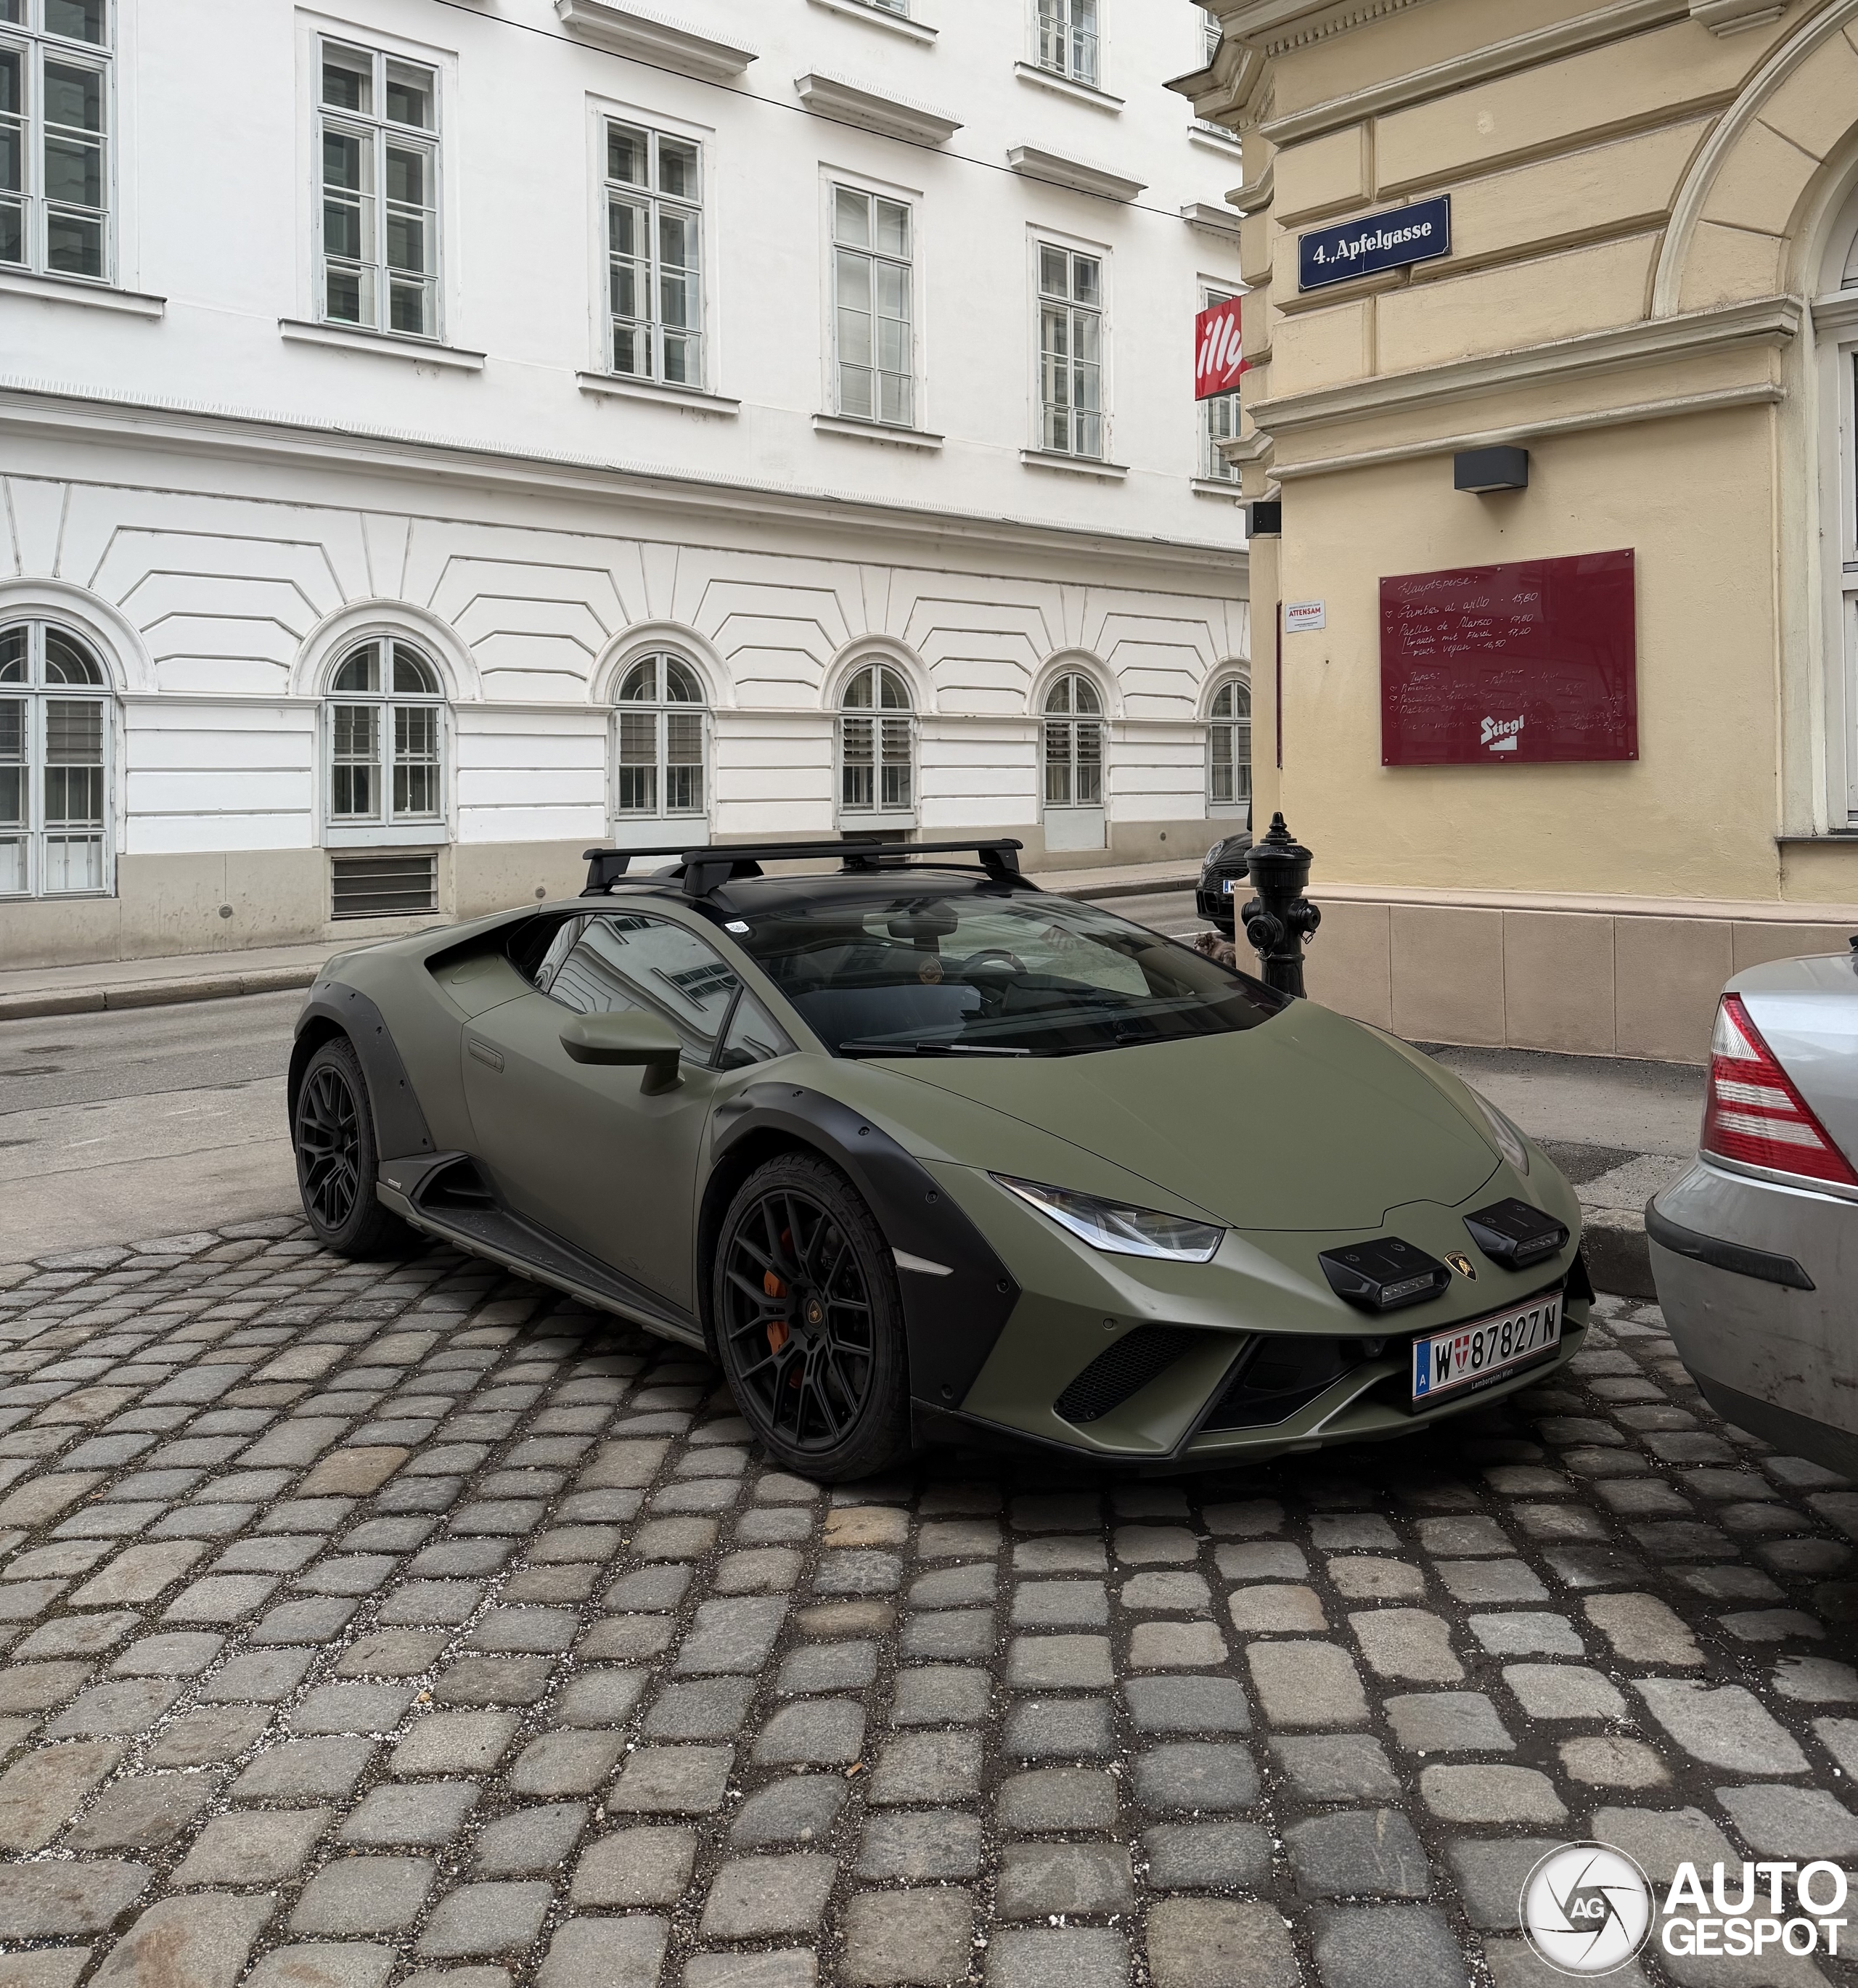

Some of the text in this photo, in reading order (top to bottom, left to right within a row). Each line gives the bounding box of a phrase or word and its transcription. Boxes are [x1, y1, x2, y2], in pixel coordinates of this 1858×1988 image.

[1197, 312, 1243, 383] illy
[1289, 607, 1320, 617] ATTENSAM
[1397, 592, 1539, 618] Gambas al ajillo 15,80
[1399, 623, 1432, 637] Paella
[1437, 621, 1449, 631] de
[1441, 633, 1459, 642] mit
[1442, 643, 1471, 658] vegan
[1410, 671, 1441, 684] Tapas:
[1481, 714, 1525, 745] Stiegl
[1436, 1303, 1556, 1383] W 87827 N
[1419, 1374, 1426, 1387] A
[1471, 1368, 1514, 1390] Lamborghini Wien
